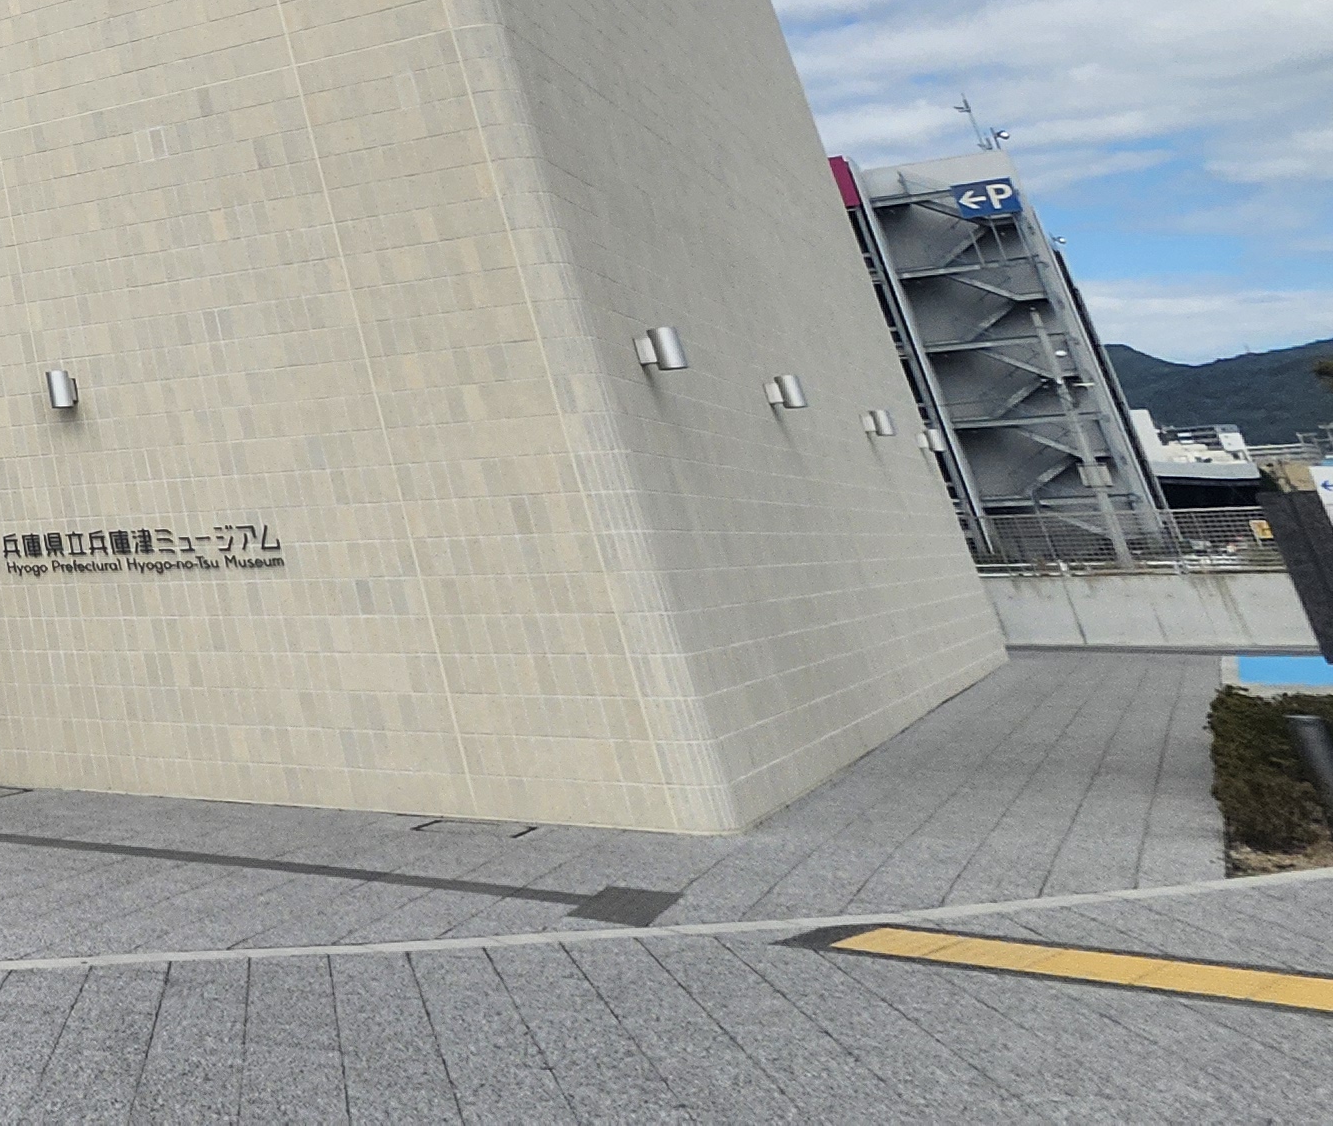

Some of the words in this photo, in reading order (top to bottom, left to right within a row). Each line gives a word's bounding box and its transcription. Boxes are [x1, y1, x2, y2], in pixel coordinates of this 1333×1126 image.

[986, 183, 1013, 209] P
[2, 525, 281, 558] 兵庫県立兵庫津ミュージアム
[7, 561, 49, 576] Hyogo
[52, 559, 122, 573] Prefectural
[127, 556, 219, 573] Hyogo-no-Tsu
[224, 555, 284, 570] Museum
